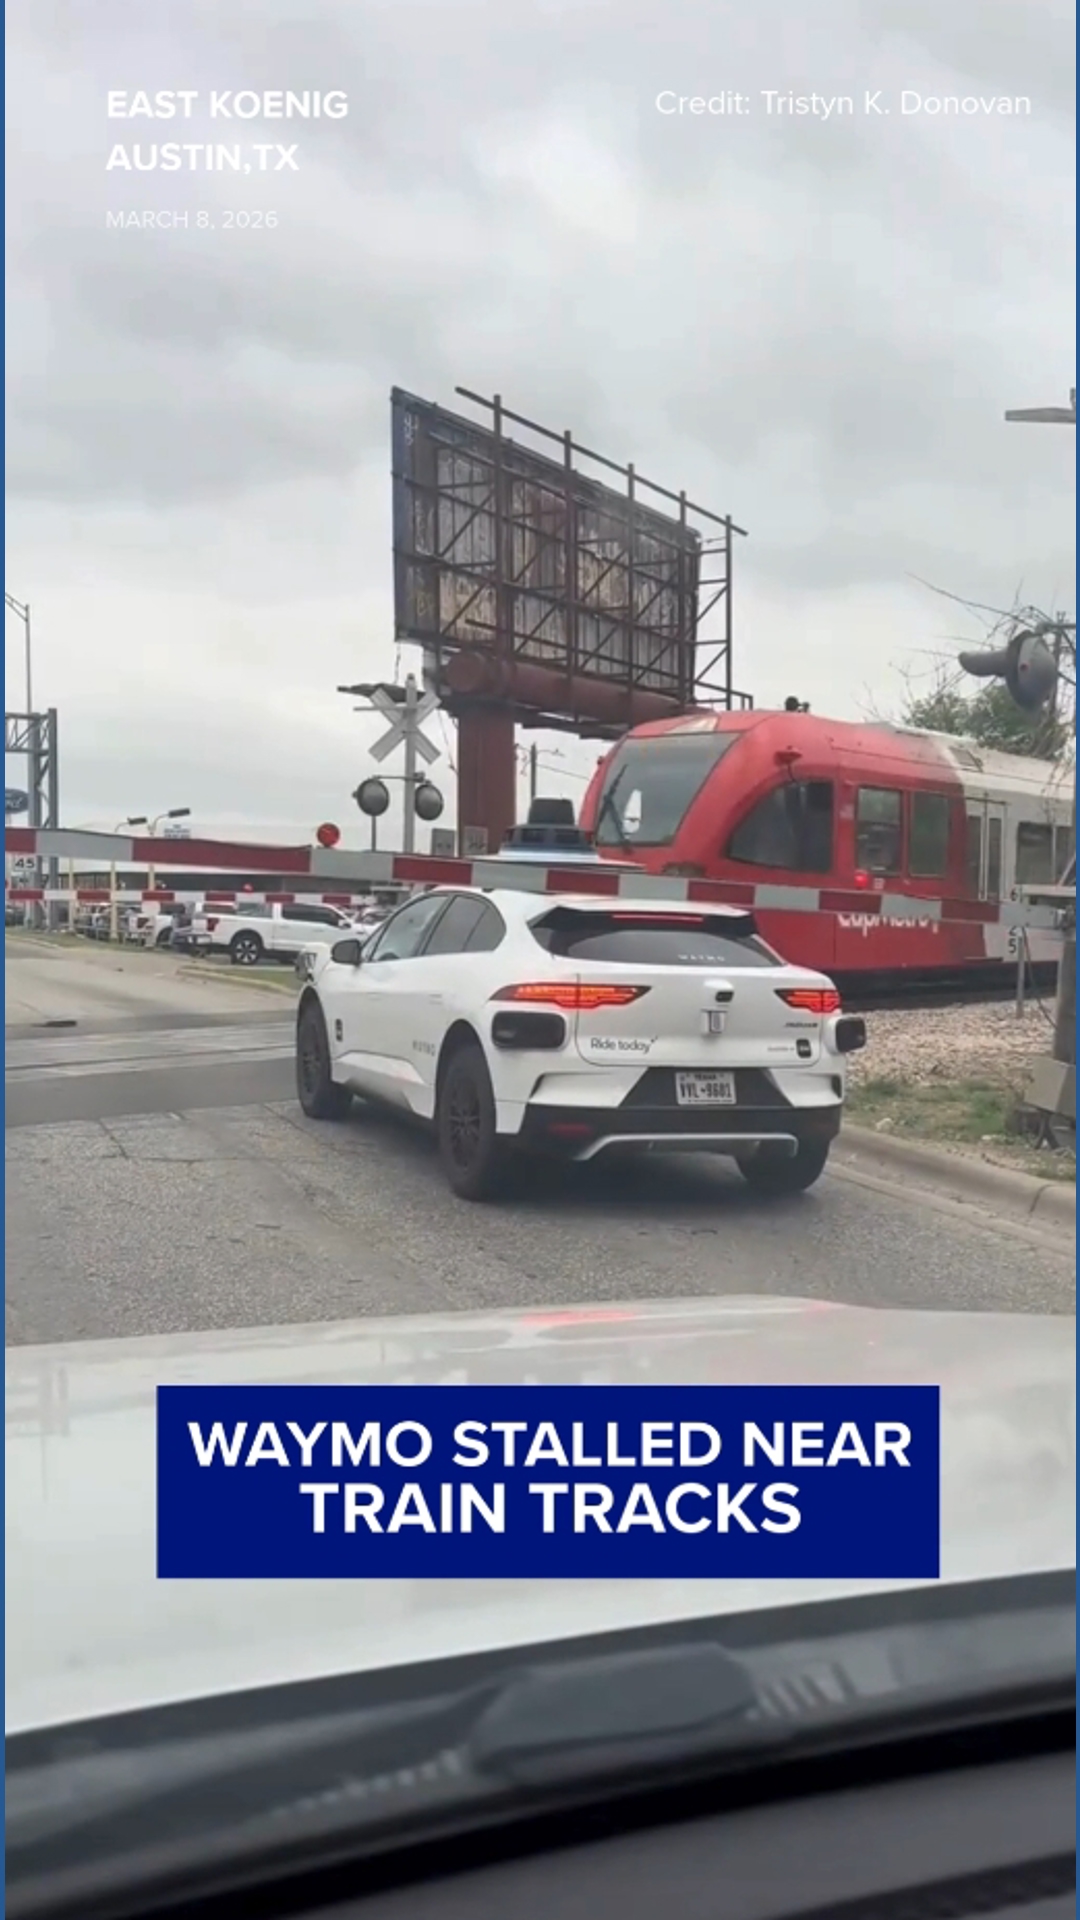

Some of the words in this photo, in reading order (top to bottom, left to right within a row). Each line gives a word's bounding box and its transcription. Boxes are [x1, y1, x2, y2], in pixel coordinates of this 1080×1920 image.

[15, 858, 35, 869] 45
[590, 1037, 616, 1050] Ride
[618, 1039, 650, 1054] today
